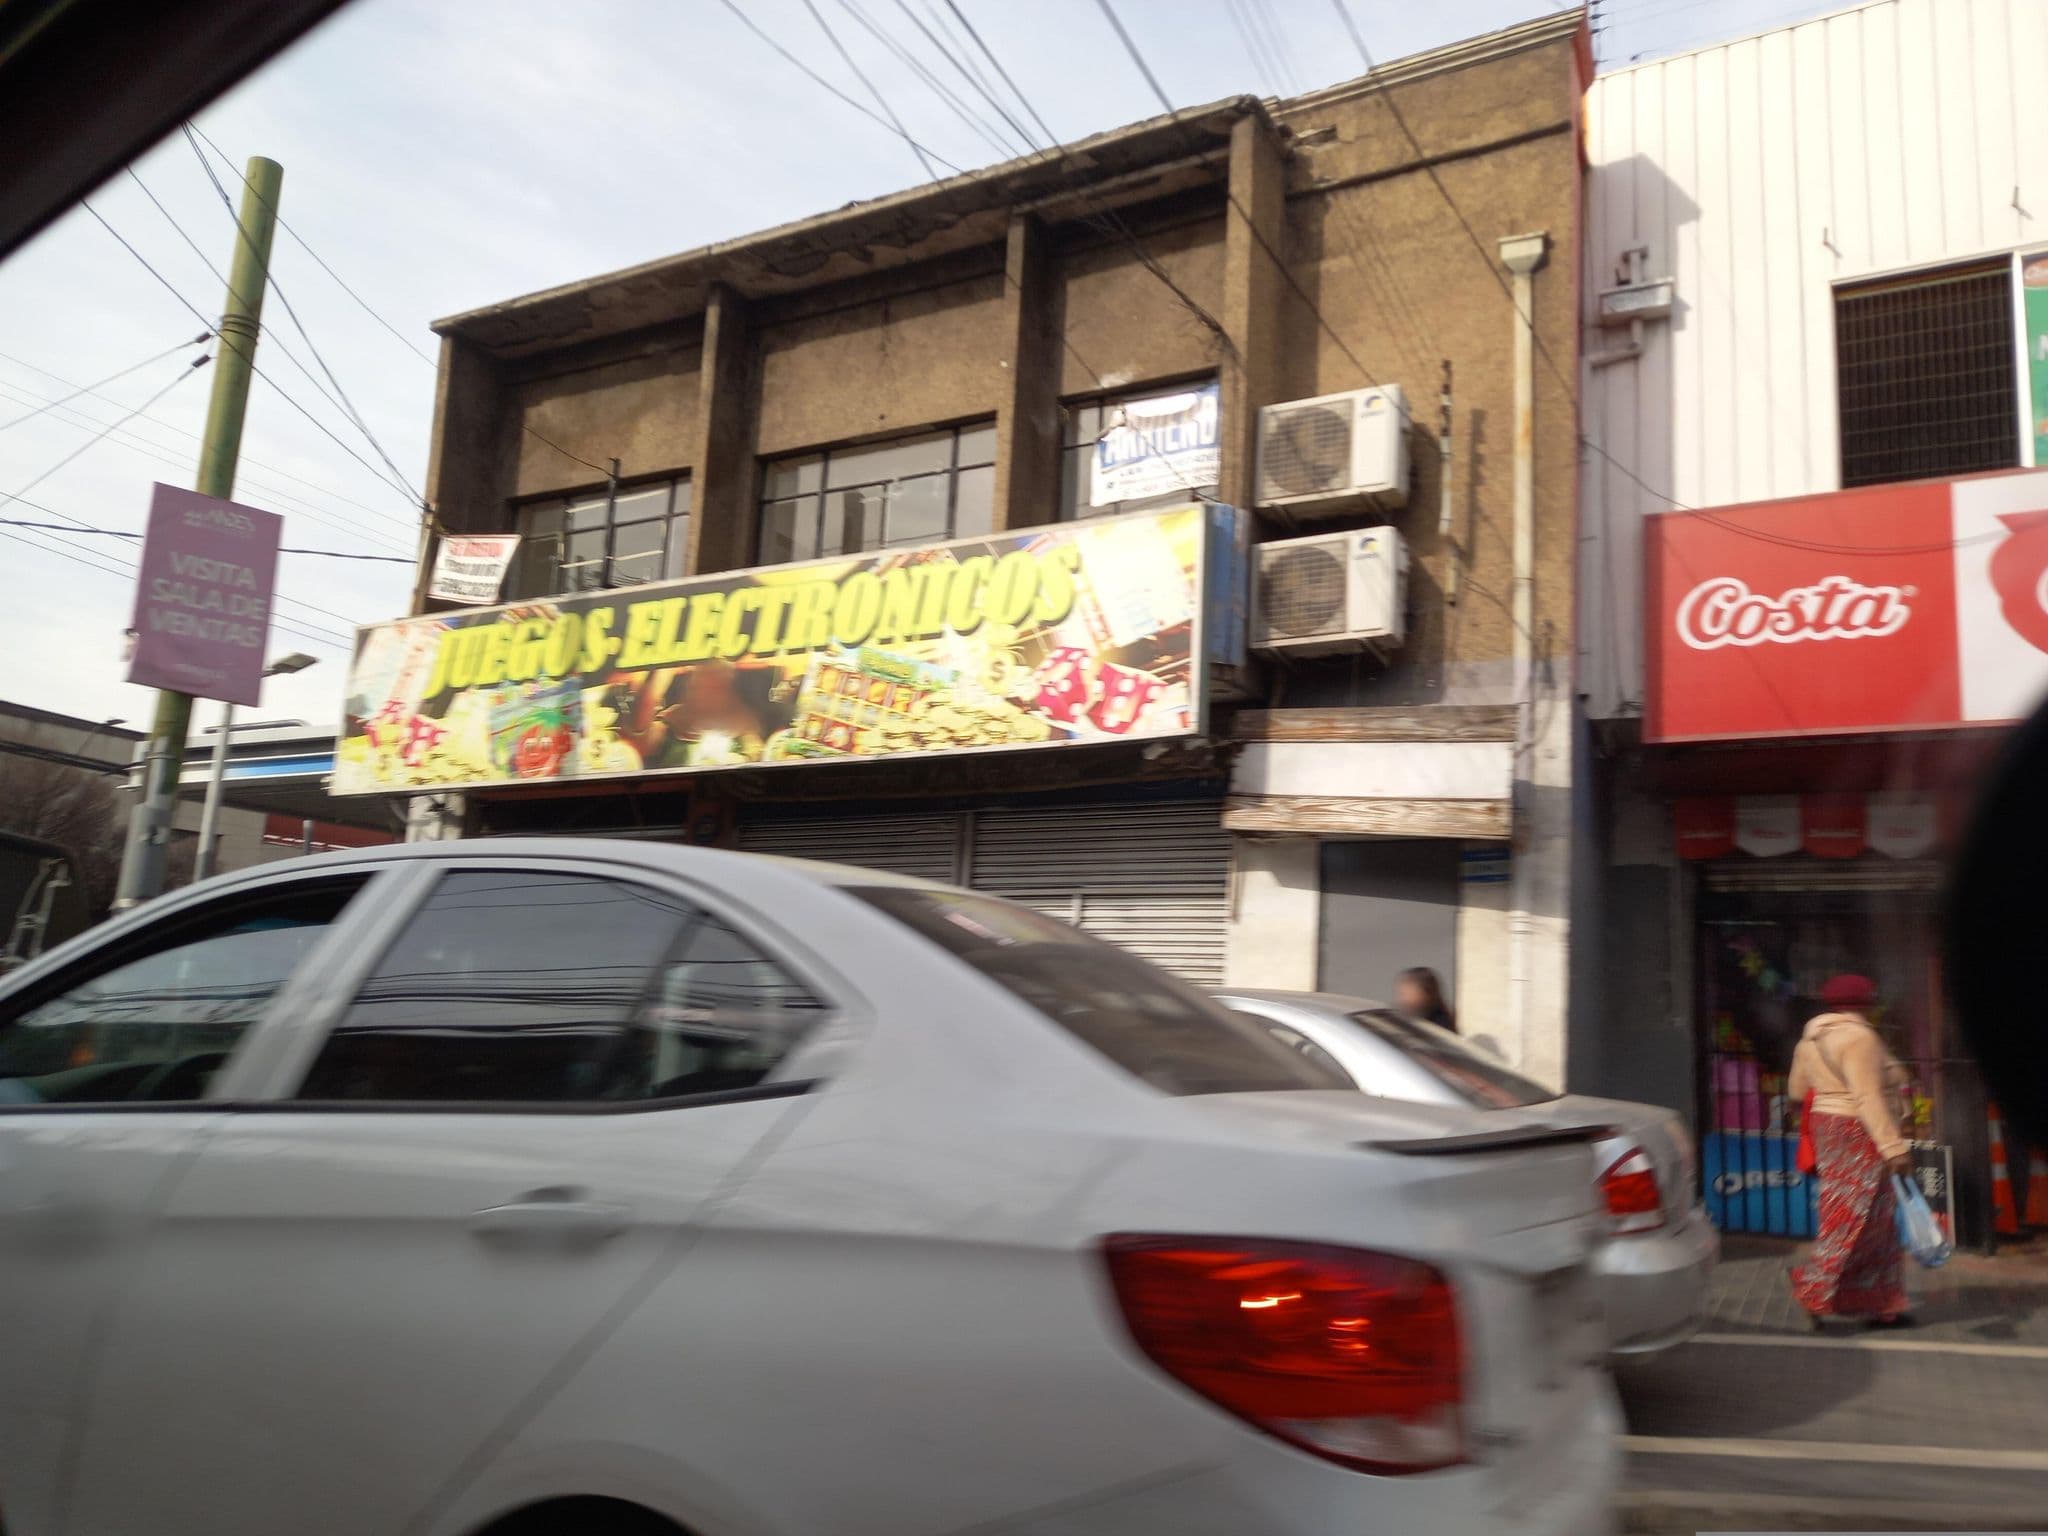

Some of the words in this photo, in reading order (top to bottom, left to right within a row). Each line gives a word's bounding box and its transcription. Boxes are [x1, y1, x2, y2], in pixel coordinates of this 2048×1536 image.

[169, 551, 257, 591] VISITA
[152, 578, 225, 615] SALA
[230, 592, 268, 621] DE
[1676, 576, 1911, 650] Costa
[149, 606, 262, 648] VENTAS
